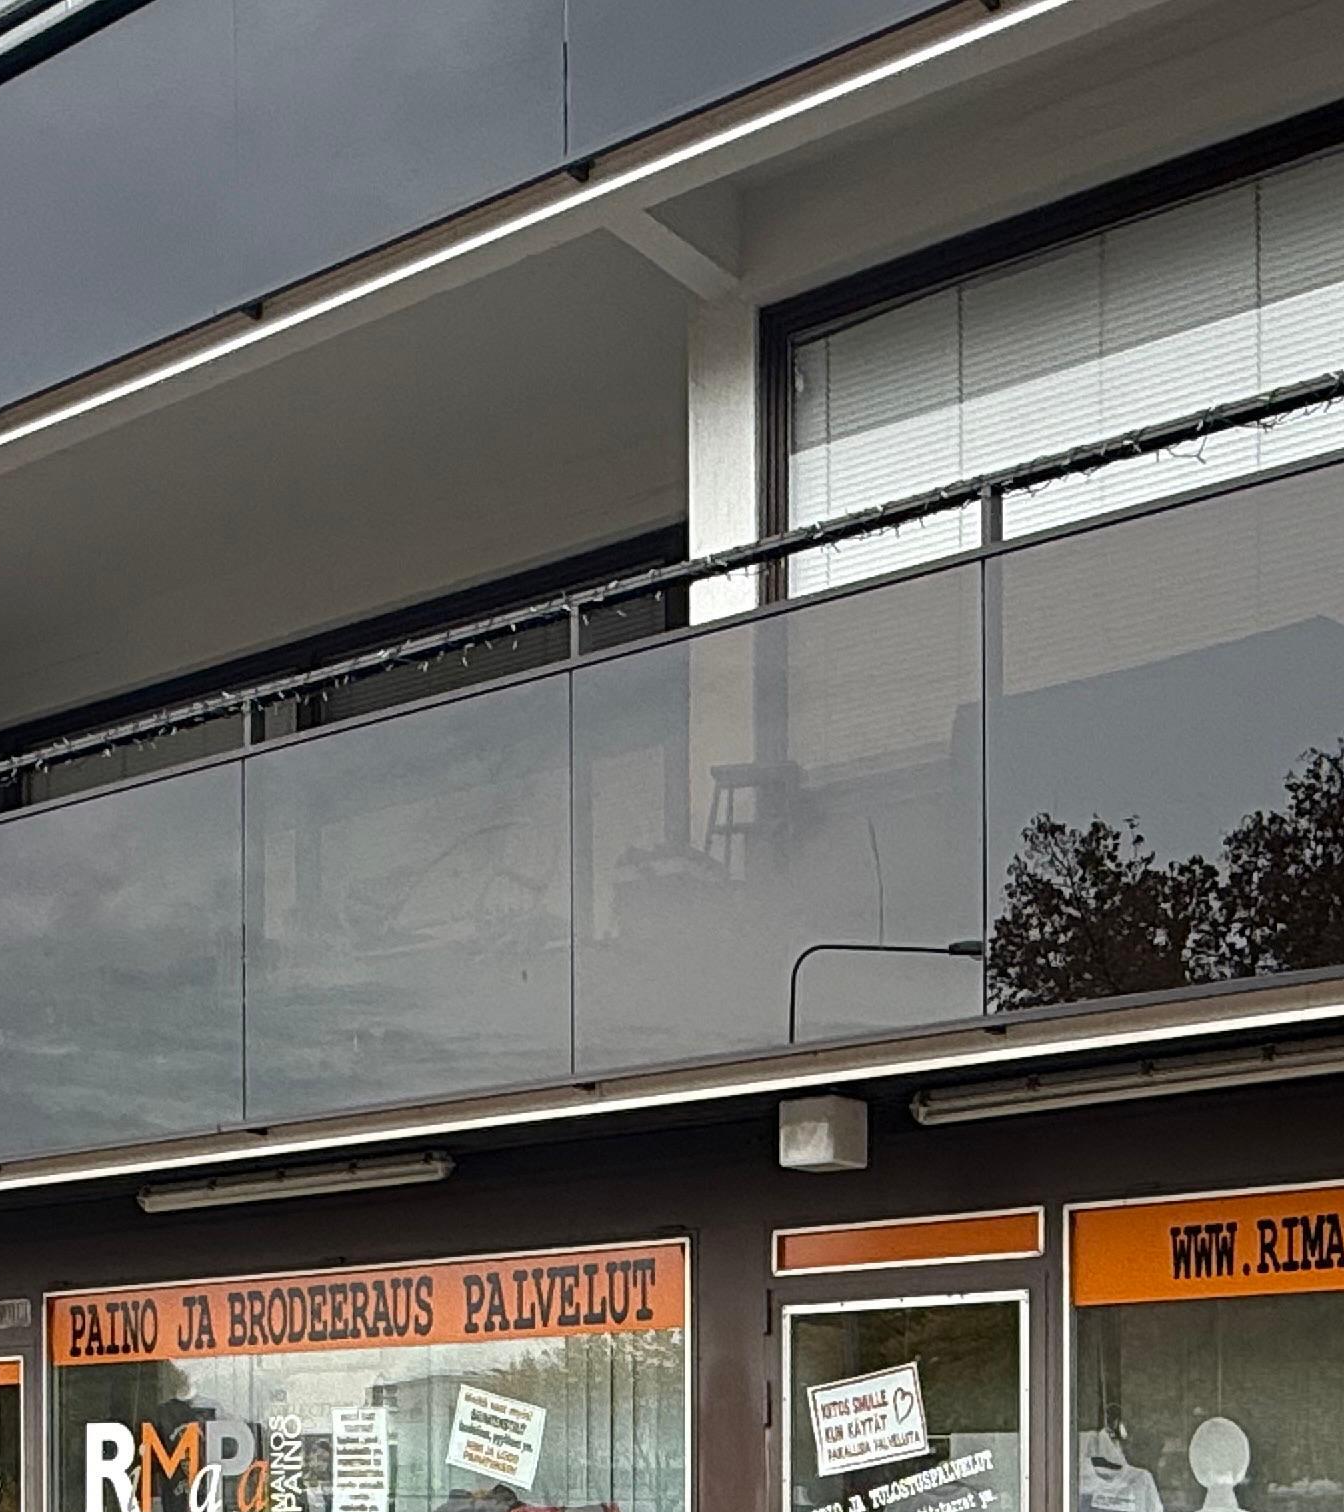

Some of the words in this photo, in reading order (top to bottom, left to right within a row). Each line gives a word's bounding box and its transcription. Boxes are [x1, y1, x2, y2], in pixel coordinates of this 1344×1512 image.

[69, 1298, 158, 1357] PAINO
[177, 1295, 216, 1352] JA
[227, 1275, 434, 1347] BRODEERAUS
[463, 1258, 656, 1334] PALVELUT
[283, 1414, 304, 1512] PAINO
[868, 1449, 994, 1510] TULOSTUSPALVELUT
